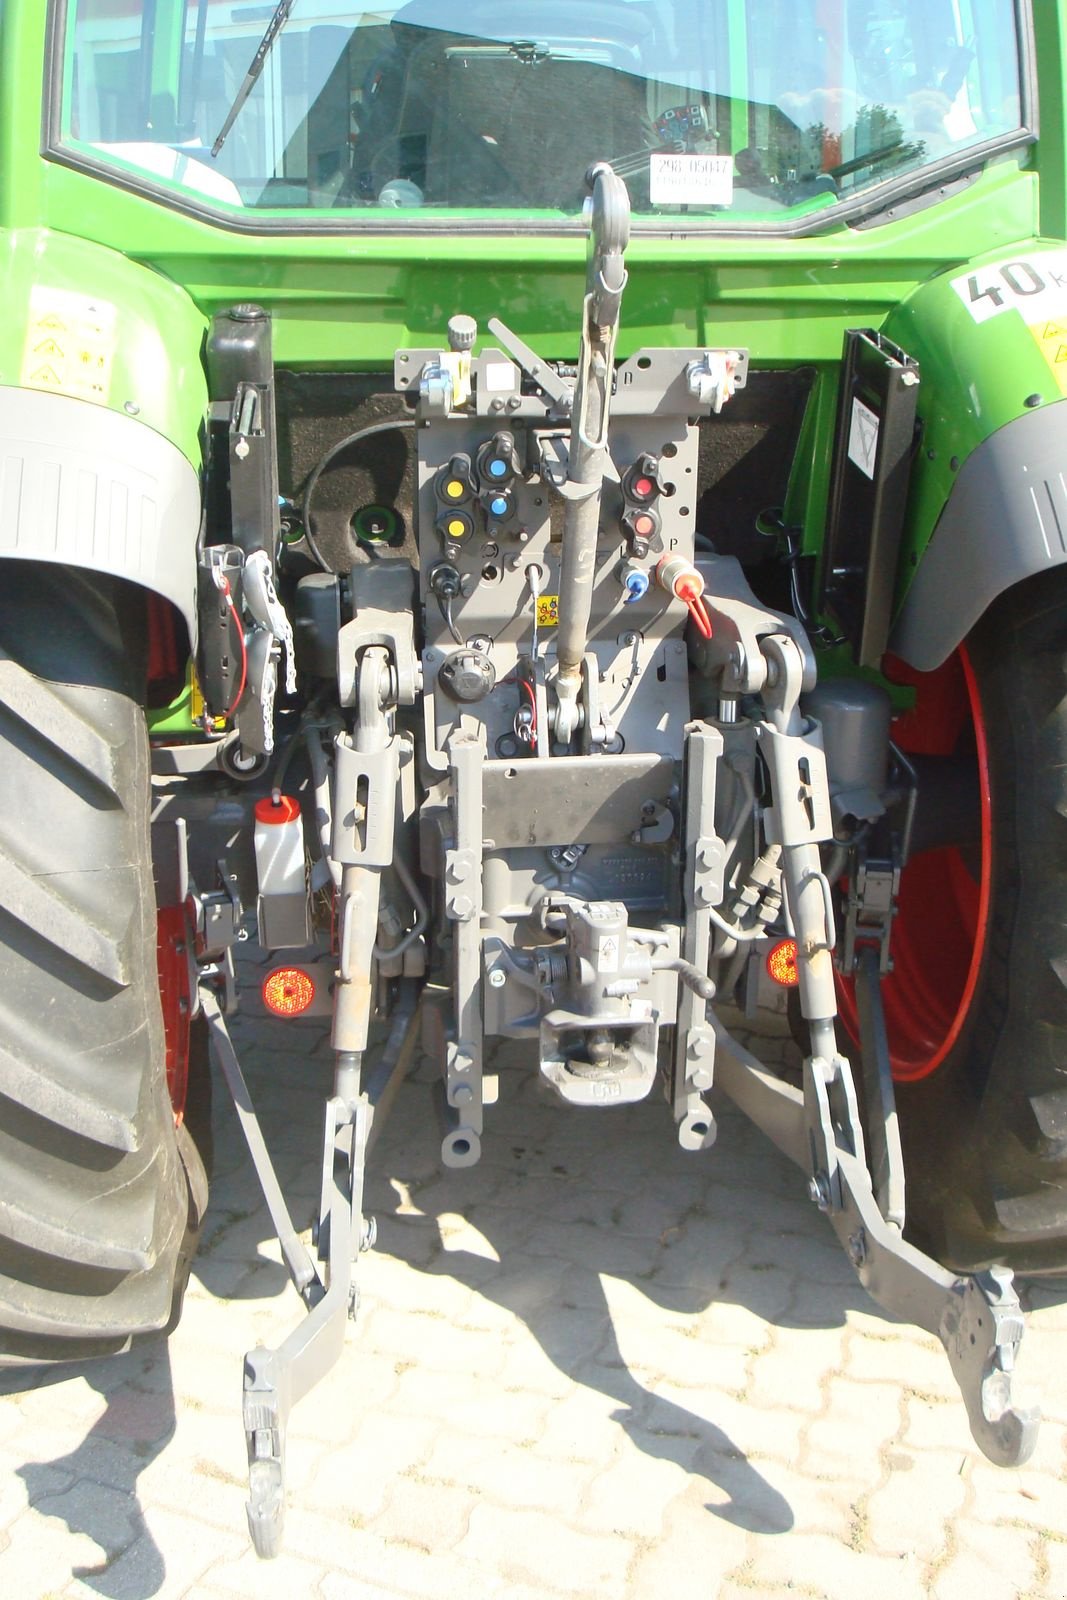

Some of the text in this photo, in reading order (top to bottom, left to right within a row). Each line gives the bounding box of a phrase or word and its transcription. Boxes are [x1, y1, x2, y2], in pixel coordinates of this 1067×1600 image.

[658, 159, 682, 173] 298
[967, 262, 1046, 307] 40
[669, 538, 678, 551] P
